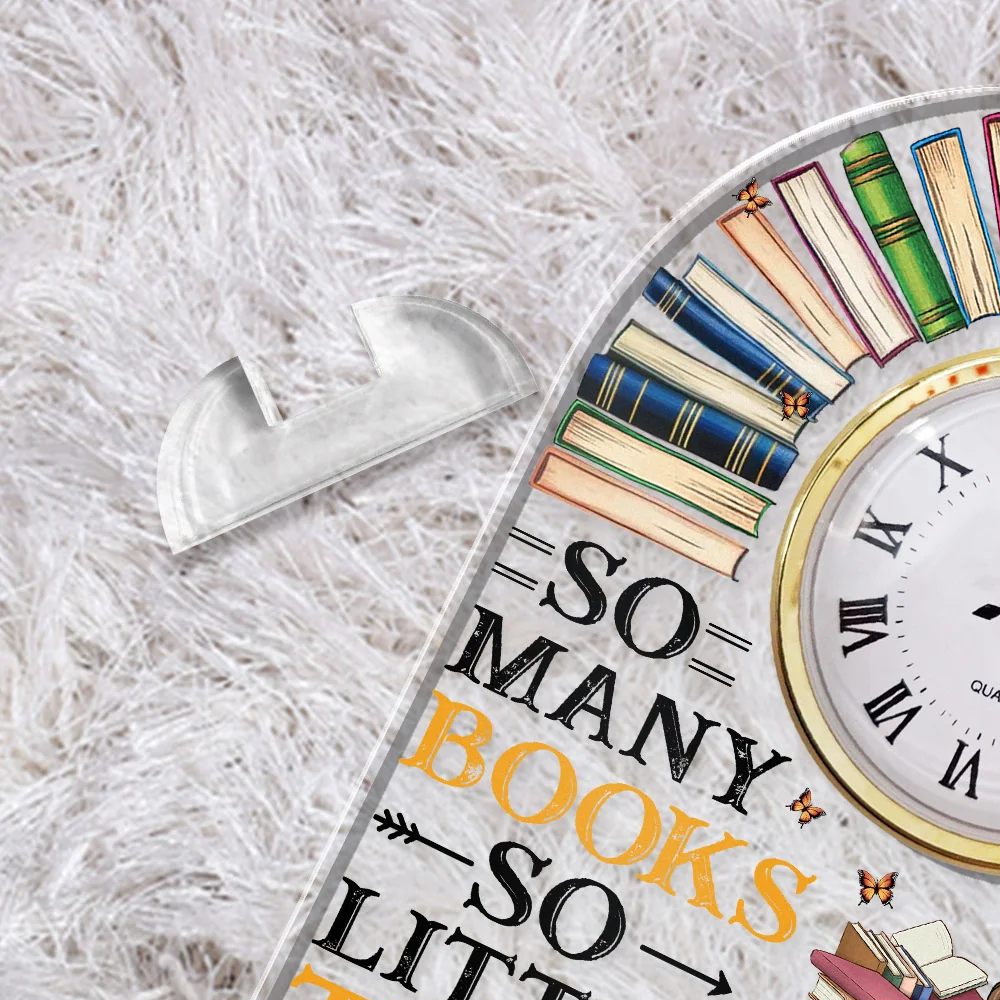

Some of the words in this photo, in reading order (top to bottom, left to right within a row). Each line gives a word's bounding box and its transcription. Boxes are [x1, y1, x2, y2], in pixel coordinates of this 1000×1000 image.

[915, 432, 974, 494] X
[852, 504, 913, 560] IX
[538, 540, 701, 660] SO
[838, 593, 890, 659] VIII
[443, 604, 793, 816] MANY
[862, 678, 923, 746] VII
[938, 738, 981, 801] VI
[397, 689, 817, 944] BOOKS
[462, 840, 627, 962] SO
